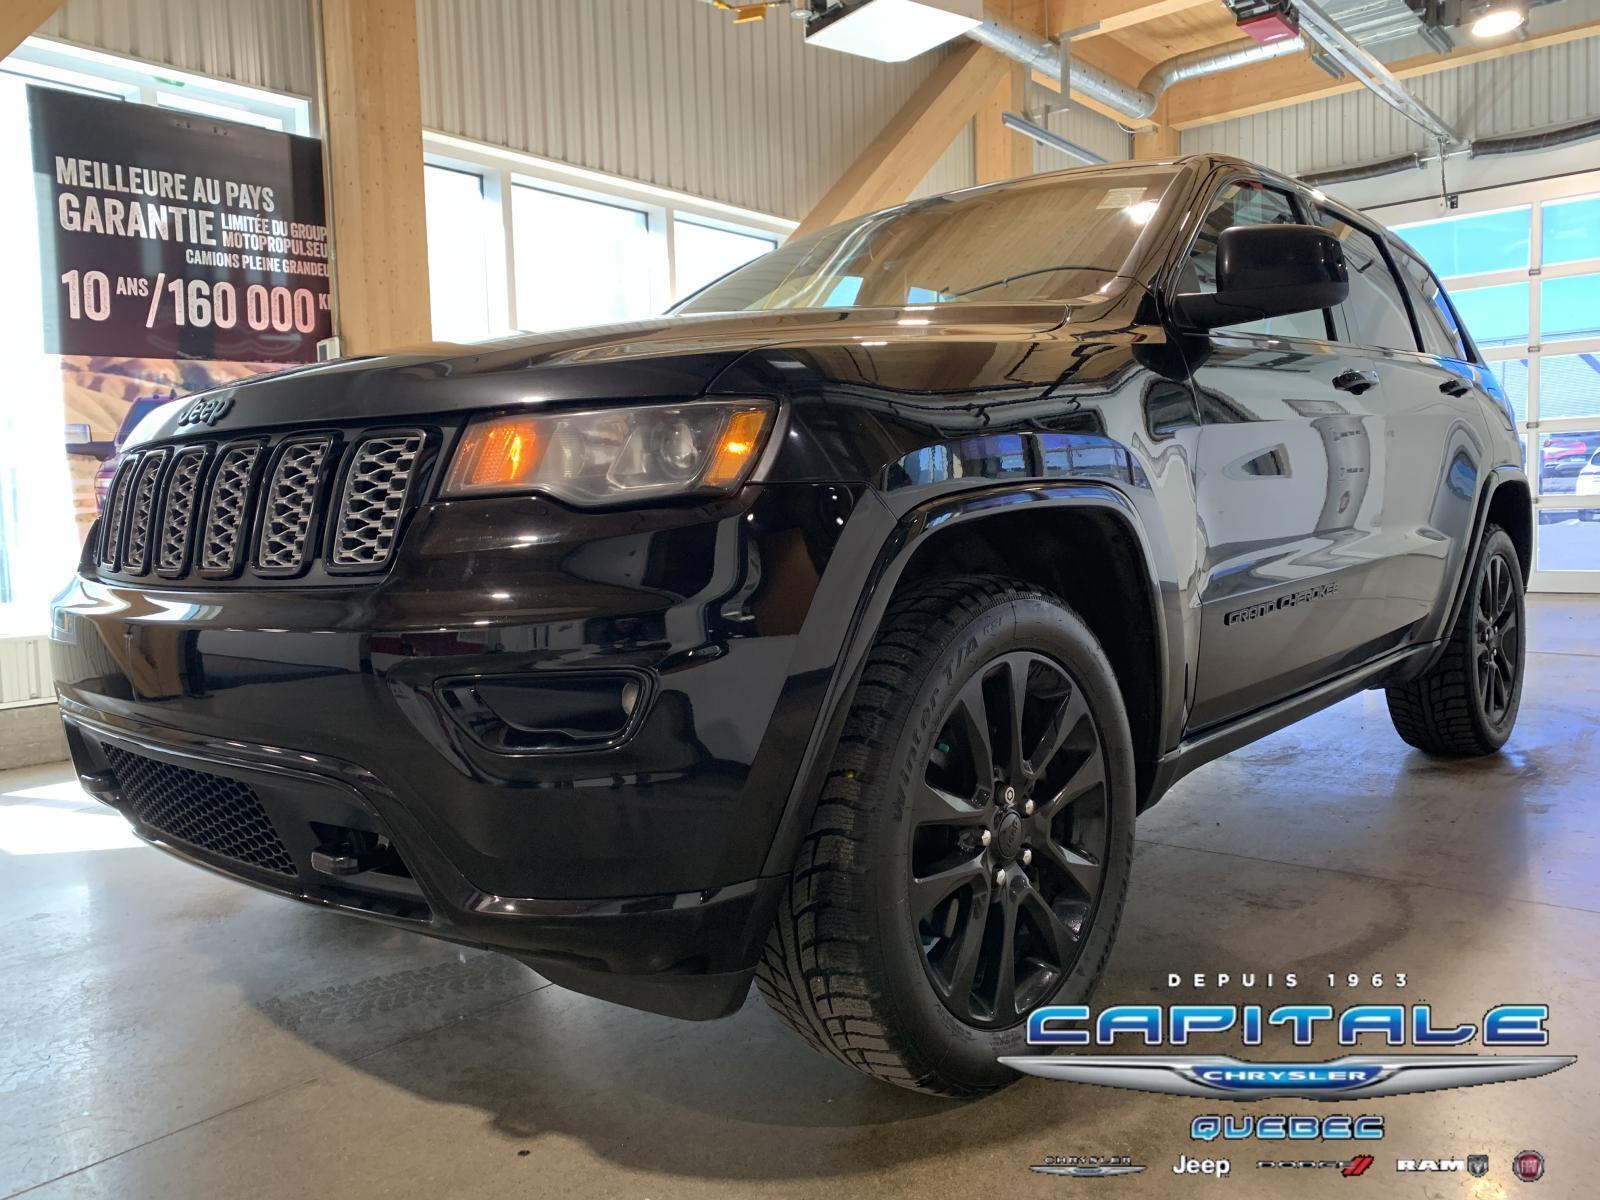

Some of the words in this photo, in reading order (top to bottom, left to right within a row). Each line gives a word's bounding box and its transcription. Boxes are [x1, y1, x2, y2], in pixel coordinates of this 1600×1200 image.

[55, 155, 189, 201] MEILLEURE
[193, 176, 220, 206] AU
[225, 181, 275, 213] PAYS
[58, 192, 218, 247] GARANTIE
[221, 213, 270, 235] LIMITÉE
[271, 219, 289, 237] DU
[185, 248, 240, 269] CAMIONS
[241, 254, 281, 273] PLEINE
[61, 269, 111, 322] 10
[246, 283, 316, 334] 000
[318, 292, 331, 310] K
[178, 398, 236, 427] Jeep
